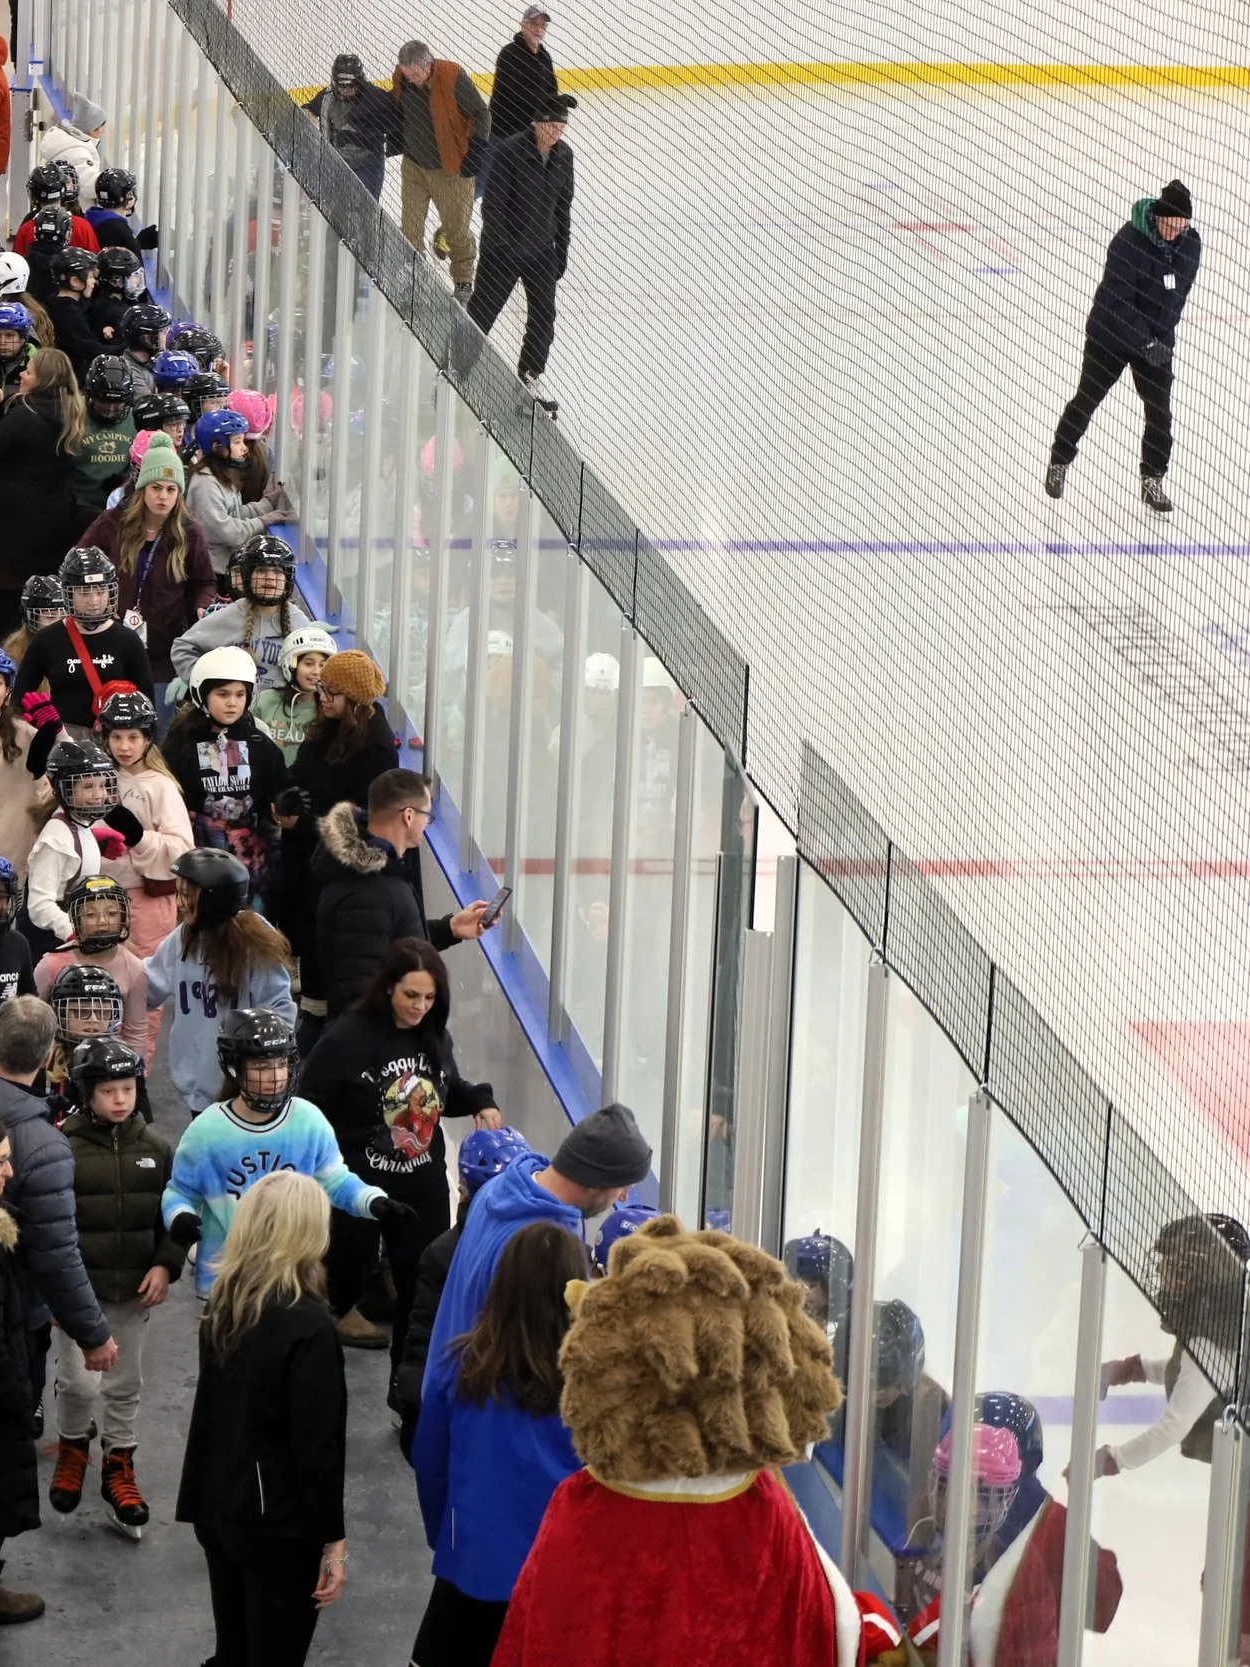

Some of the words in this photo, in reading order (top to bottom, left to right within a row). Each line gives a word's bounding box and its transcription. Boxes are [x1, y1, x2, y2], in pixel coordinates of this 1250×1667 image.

[82, 435, 95, 445] MY
[95, 432, 133, 445] CAMPING
[90, 454, 127, 463] HOODIE
[66, 658, 82, 674] goo
[270, 728, 306, 743] BEAU
[83, 984, 108, 992] CCM
[262, 1037, 287, 1047] CCM
[110, 1061, 131, 1070] CCM
